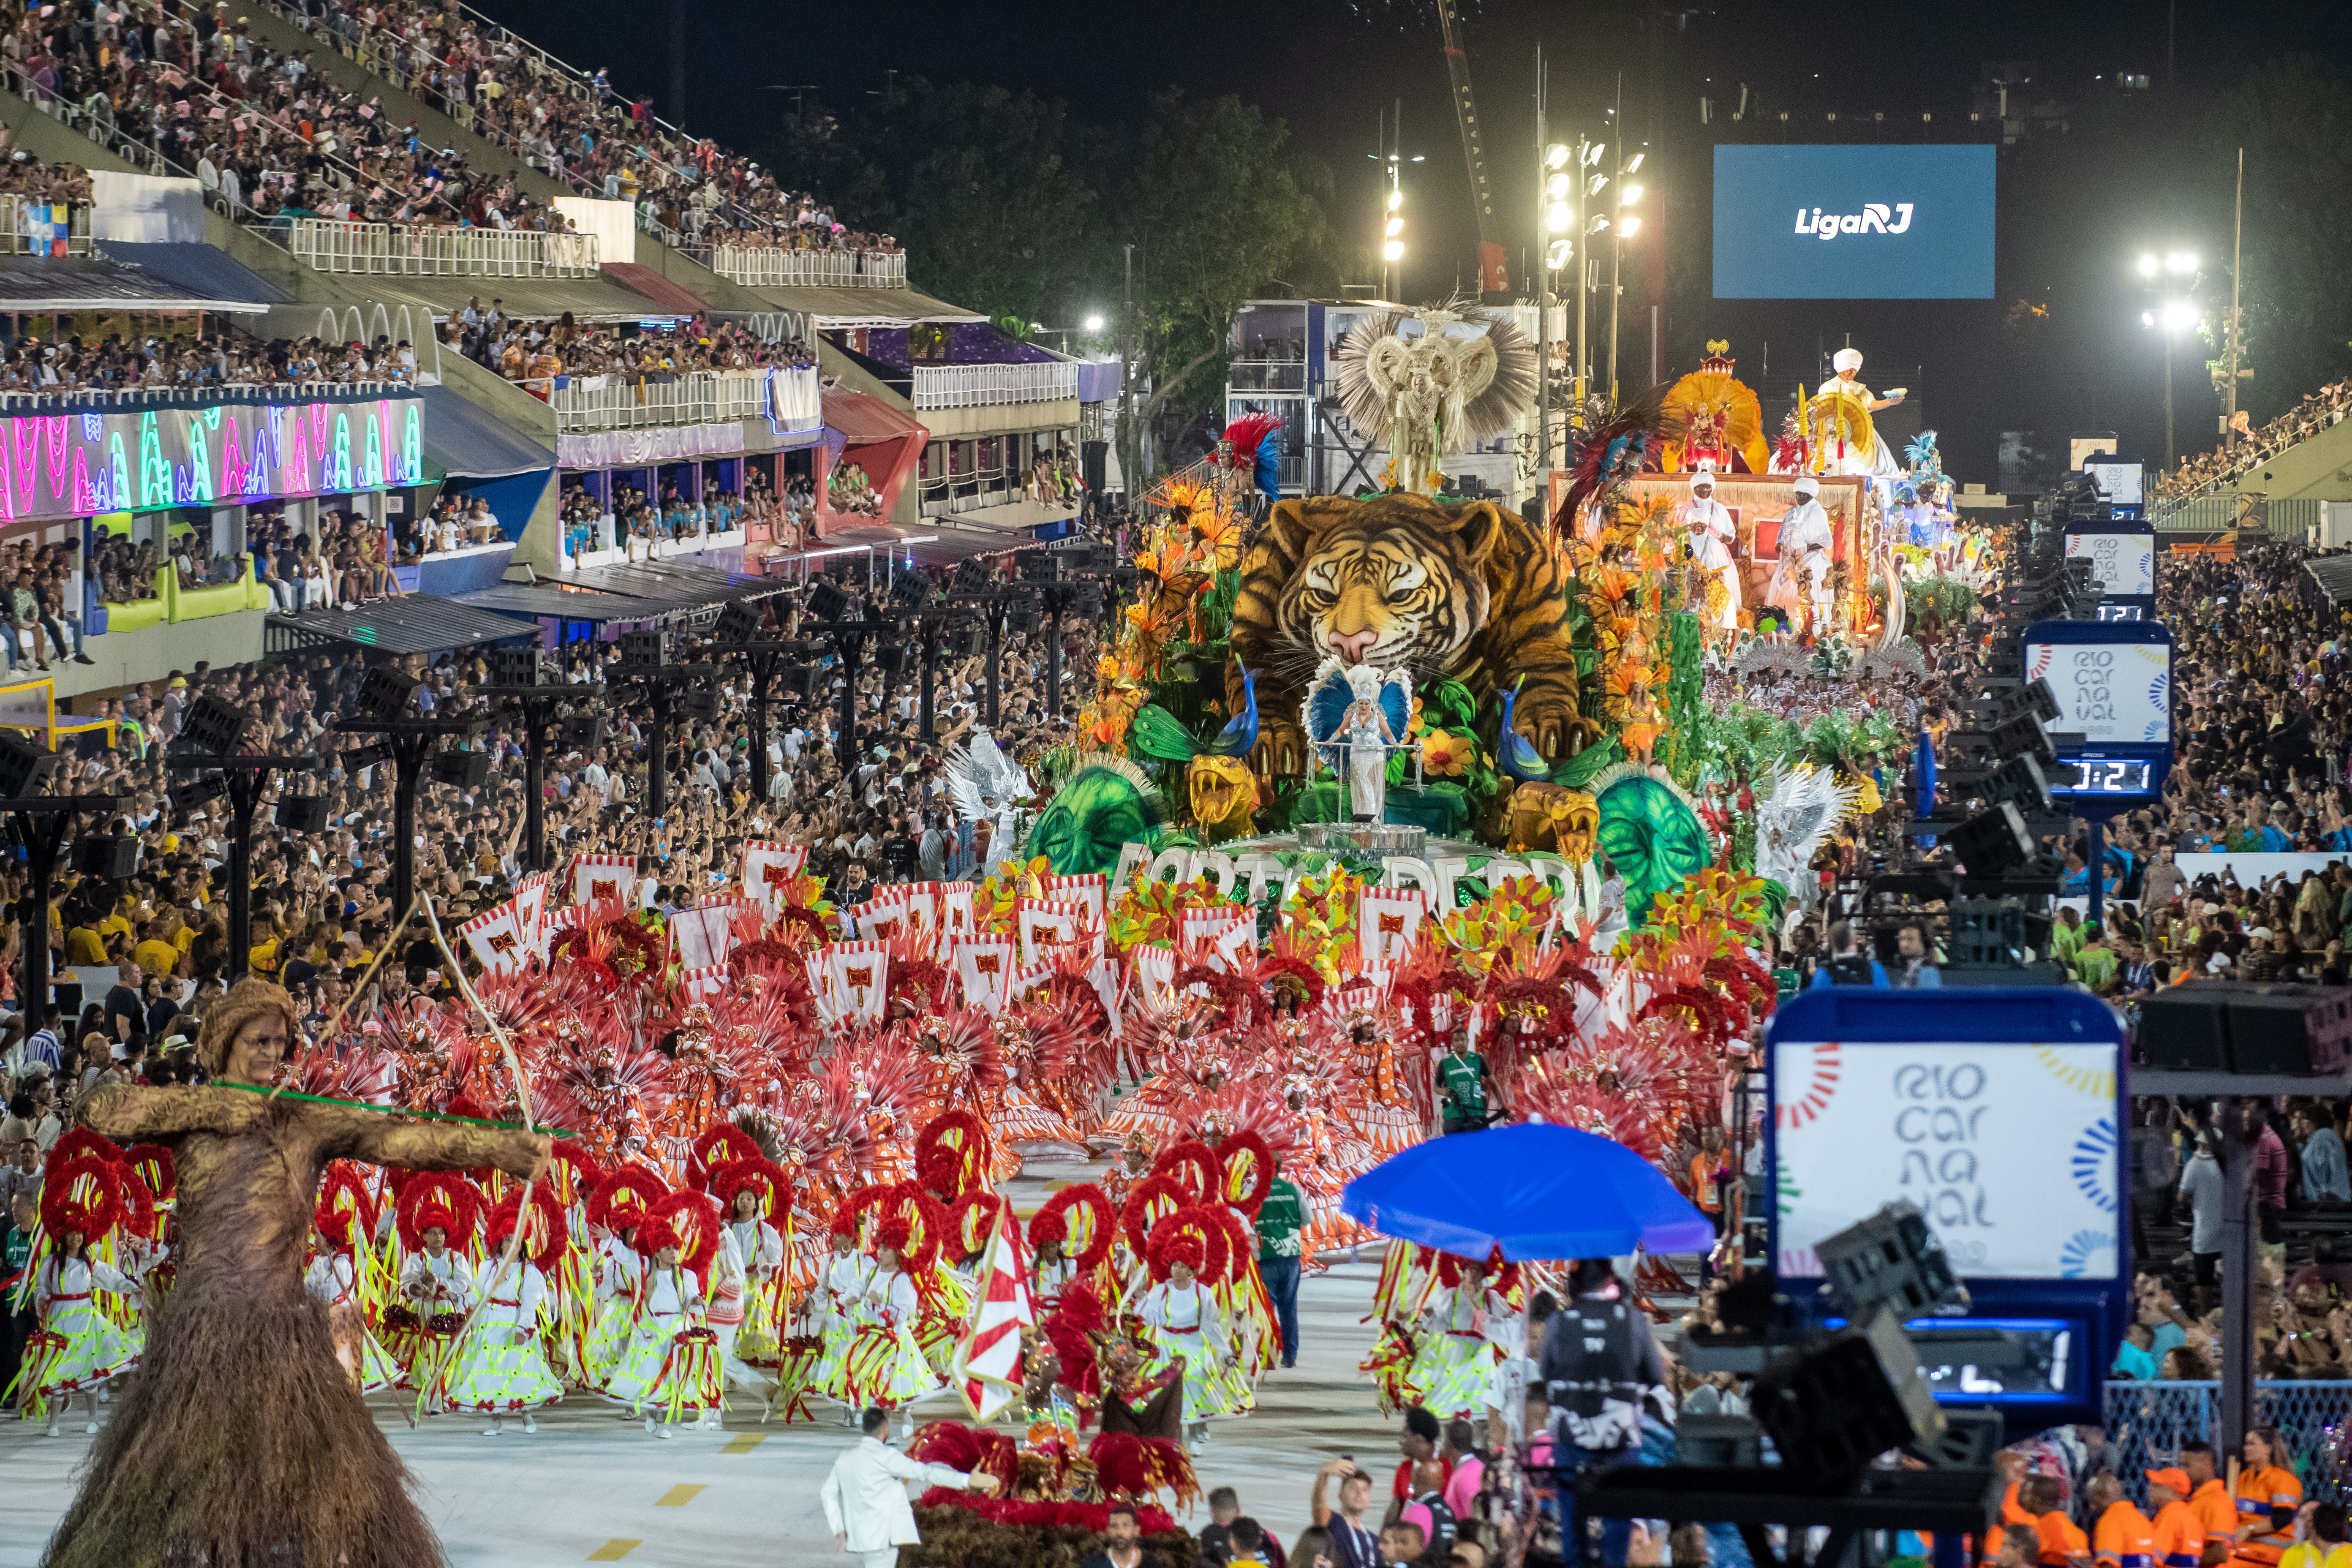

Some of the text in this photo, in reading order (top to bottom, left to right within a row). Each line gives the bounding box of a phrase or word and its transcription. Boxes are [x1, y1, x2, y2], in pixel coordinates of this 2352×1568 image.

[1794, 203, 1914, 240] LigaRJ
[2073, 651, 2114, 667] RIO
[1894, 1063, 1988, 1101] RIO
